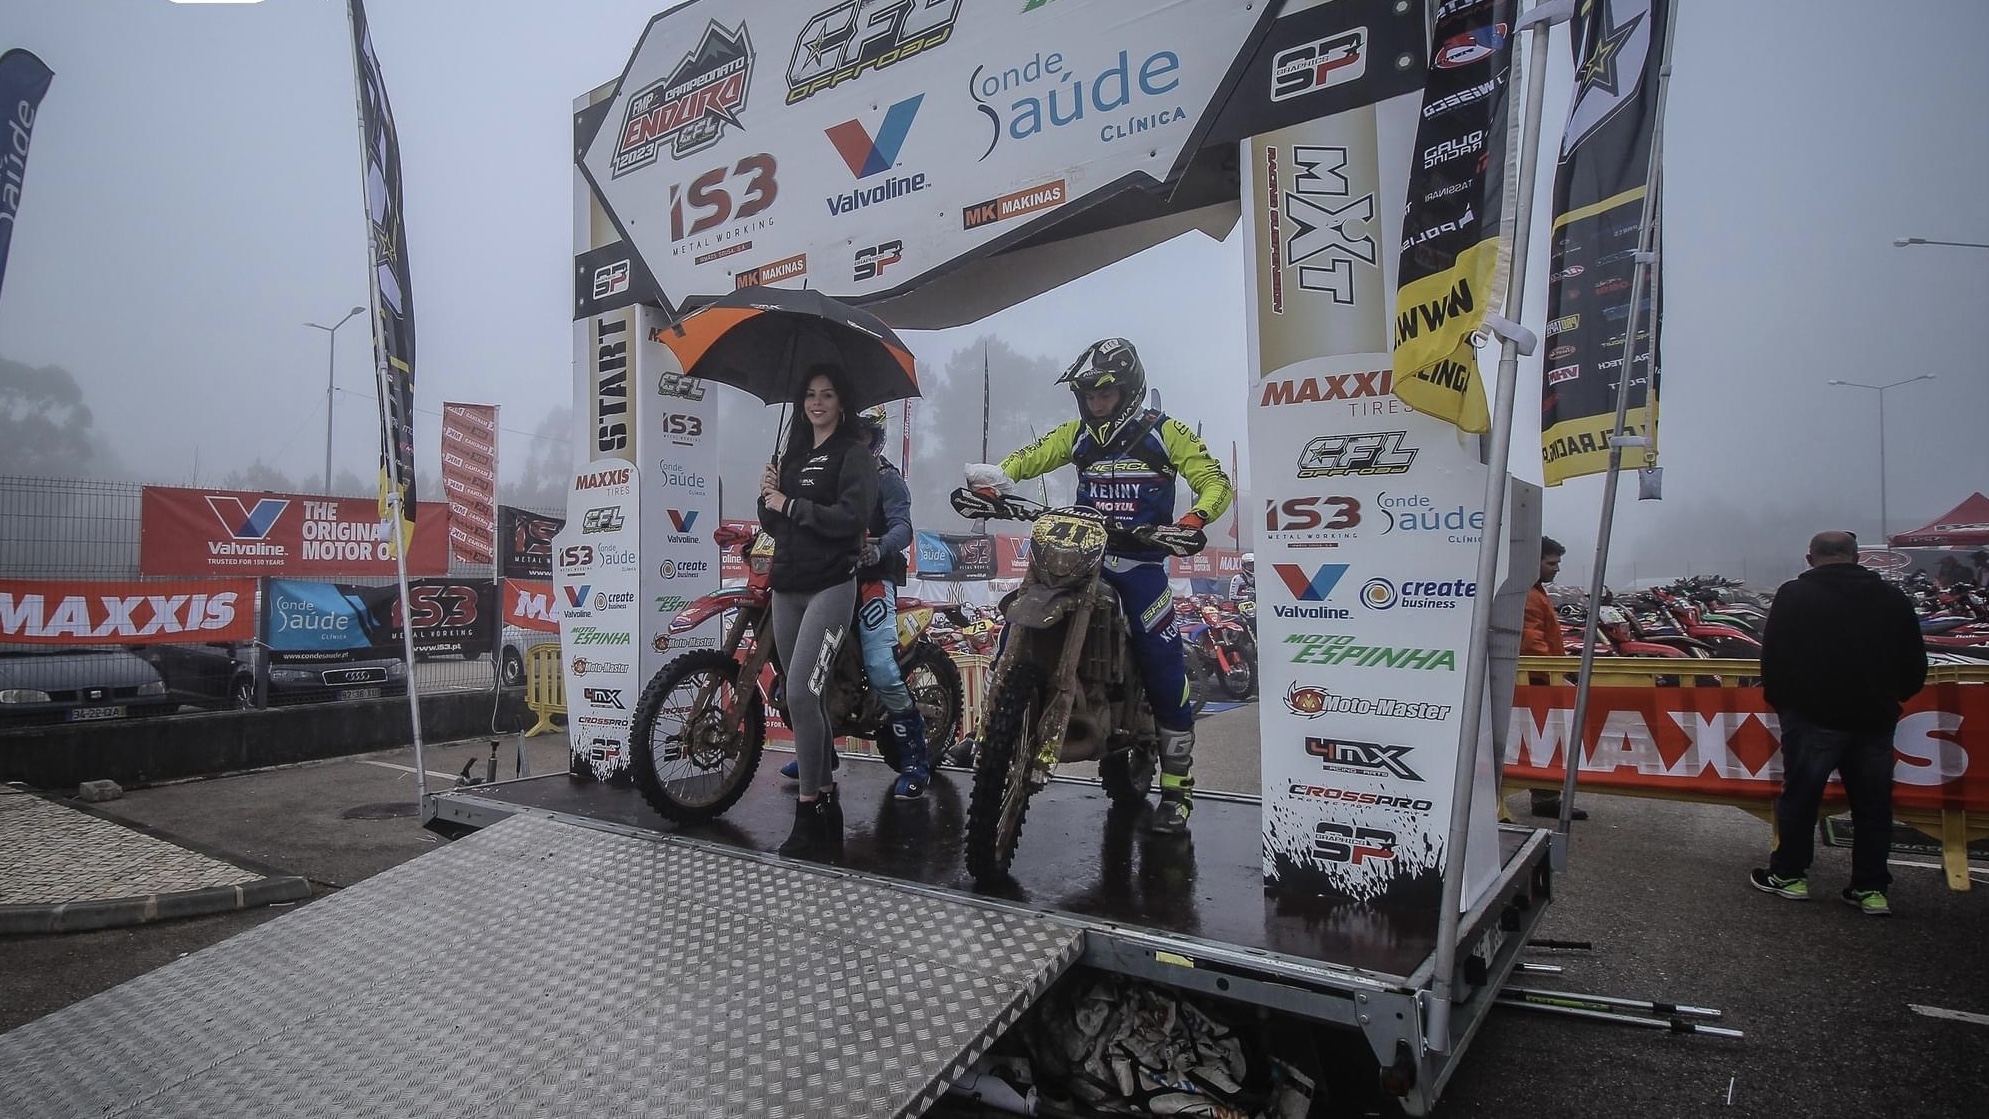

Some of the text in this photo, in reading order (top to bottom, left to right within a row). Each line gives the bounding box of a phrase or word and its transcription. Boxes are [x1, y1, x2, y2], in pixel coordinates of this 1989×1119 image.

[665, 57, 744, 100] CAMPEONATO
[619, 143, 654, 168] 2023
[826, 172, 926, 216] Valvoline
[965, 187, 1061, 226] MK MAKINAS
[1285, 145, 1378, 305] MXT
[672, 217, 774, 256] METAL WORKING
[737, 259, 804, 288] MK MAKINAS
[598, 319, 627, 452] START
[1260, 369, 1393, 407] MAXXI
[575, 468, 630, 490] MAXXIS
[606, 487, 630, 497] TIRES
[1089, 482, 1140, 498] KENNY
[303, 501, 338, 521] THE
[1095, 501, 1135, 512] MOTUL
[302, 521, 381, 541] ORIGINA
[667, 535, 700, 544] Valvoline
[1306, 532, 1358, 540] WORKING
[207, 541, 286, 556] Valvoline
[302, 541, 372, 561] MOTOR
[677, 561, 707, 571] create
[608, 592, 634, 602] create
[1401, 579, 1476, 598] create
[658, 601, 688, 612] ESPI
[1273, 605, 1349, 620] Valvoline
[1401, 599, 1456, 609] business
[0, 592, 238, 637] MAXXIS
[391, 631, 425, 639] MEAL
[971, 621, 987, 634] 73
[573, 632, 631, 645] ESPINHA
[1283, 634, 1356, 645] MOTO
[585, 661, 629, 673] Moto-Master
[1290, 644, 1455, 672] ESPINHA
[1322, 695, 1451, 721] Moto-Master
[579, 716, 628, 727] CROSSPRO
[1504, 706, 1968, 786] MAXS
[1289, 784, 1432, 811] CROSSPRO
